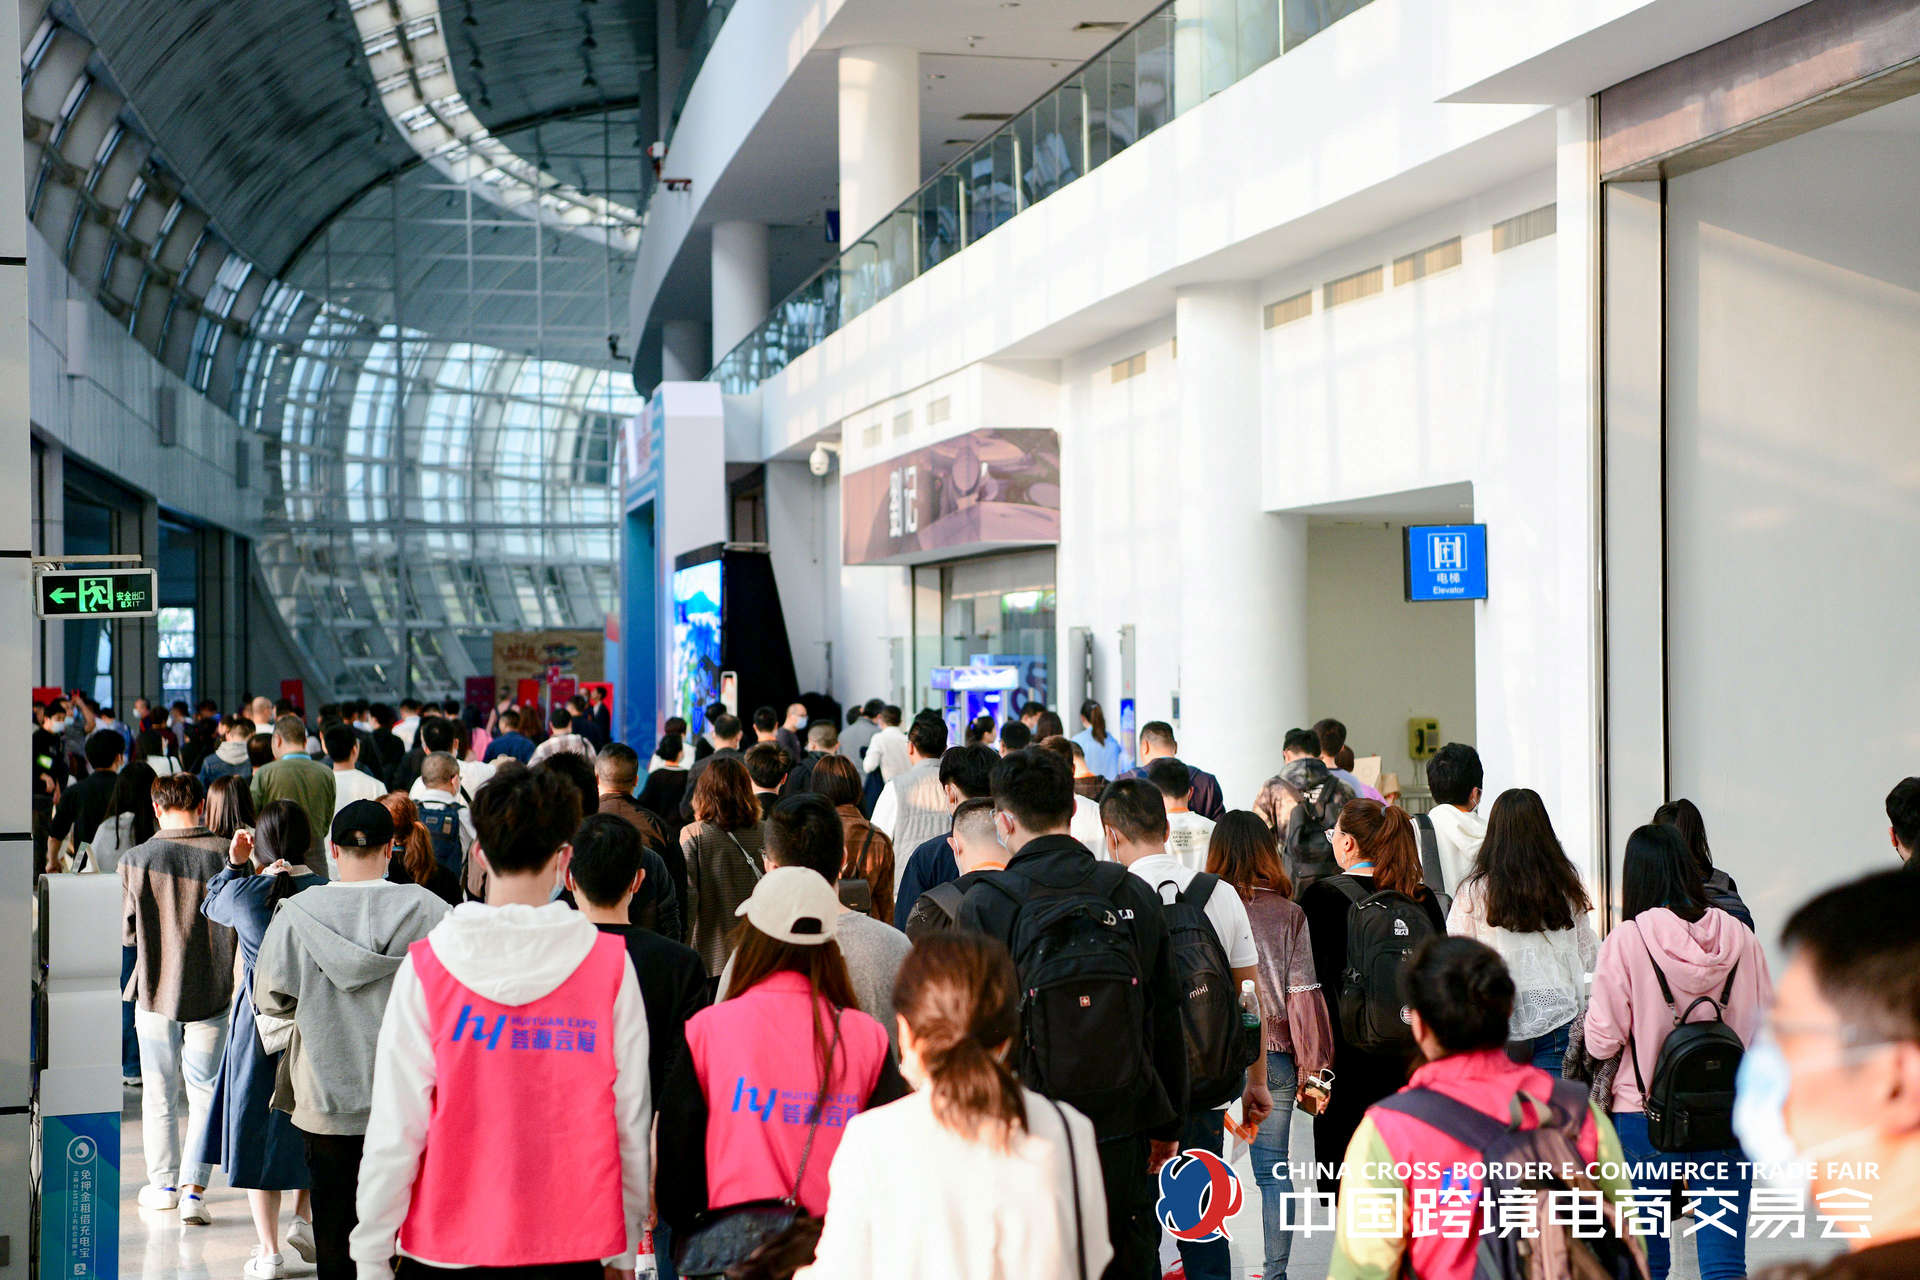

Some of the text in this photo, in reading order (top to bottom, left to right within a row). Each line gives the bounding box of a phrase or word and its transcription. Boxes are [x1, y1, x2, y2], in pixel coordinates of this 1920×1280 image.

[1437, 573, 1460, 584] 电梯
[1433, 586, 1465, 594] Elevator
[116, 591, 145, 601] 安全出口
[79, 1169, 92, 1258] 免押金租借充电宝
